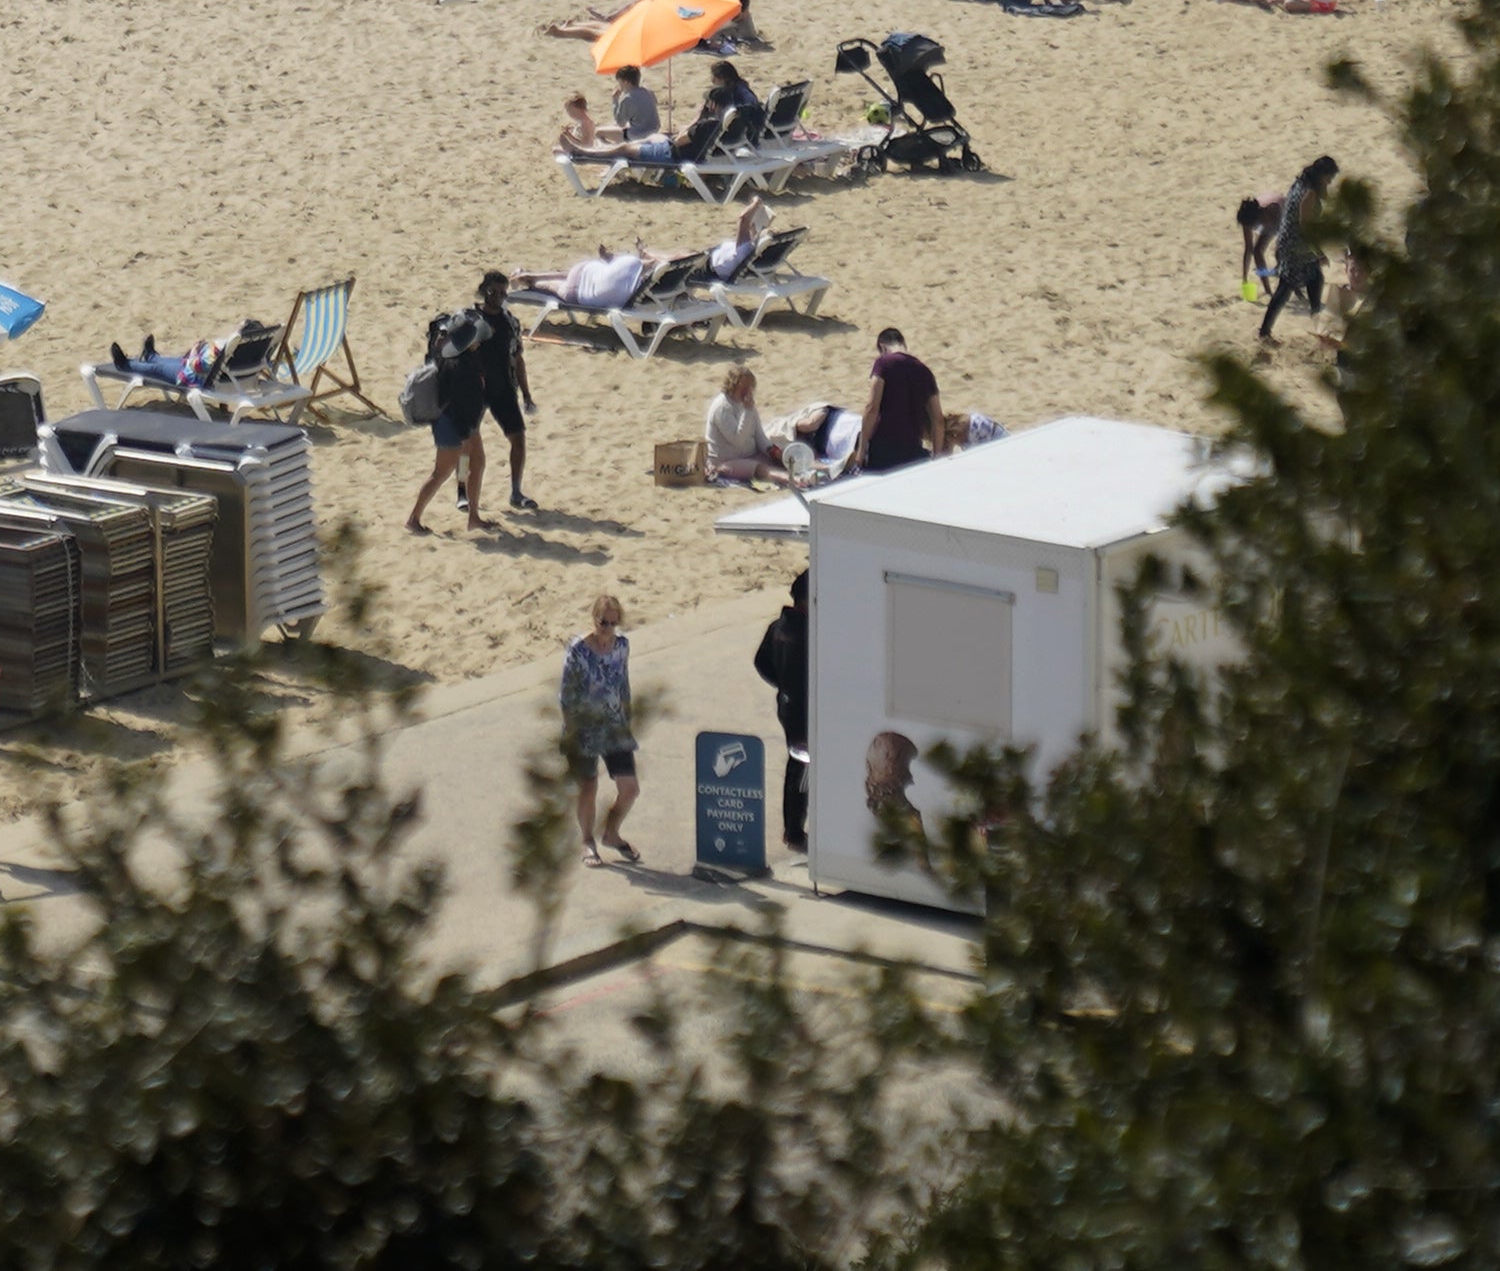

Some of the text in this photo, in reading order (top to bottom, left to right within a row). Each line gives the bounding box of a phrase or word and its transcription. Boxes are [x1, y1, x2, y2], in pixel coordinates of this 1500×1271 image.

[698, 784, 764, 800] CONTACTLESS
[718, 799, 744, 810] CARD
[707, 809, 755, 822] PAYMENTS
[718, 821, 744, 833] ONLY
